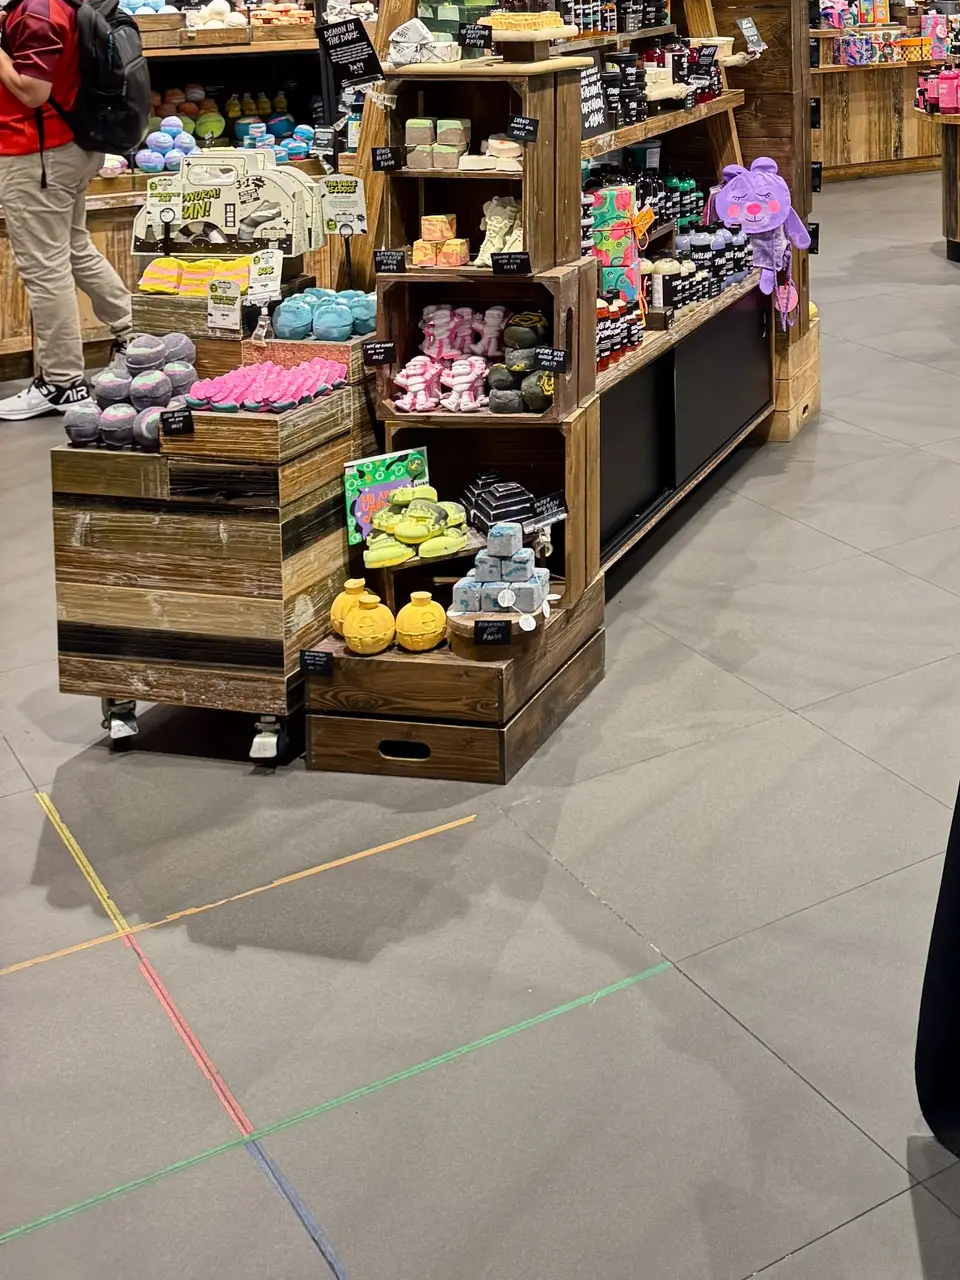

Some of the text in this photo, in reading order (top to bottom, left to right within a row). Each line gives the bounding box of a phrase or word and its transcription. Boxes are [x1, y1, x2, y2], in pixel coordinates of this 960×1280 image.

[324, 22, 355, 38] DEMON IN
[326, 30, 360, 46] THE DARK
[60, 386, 88, 404] AIR
